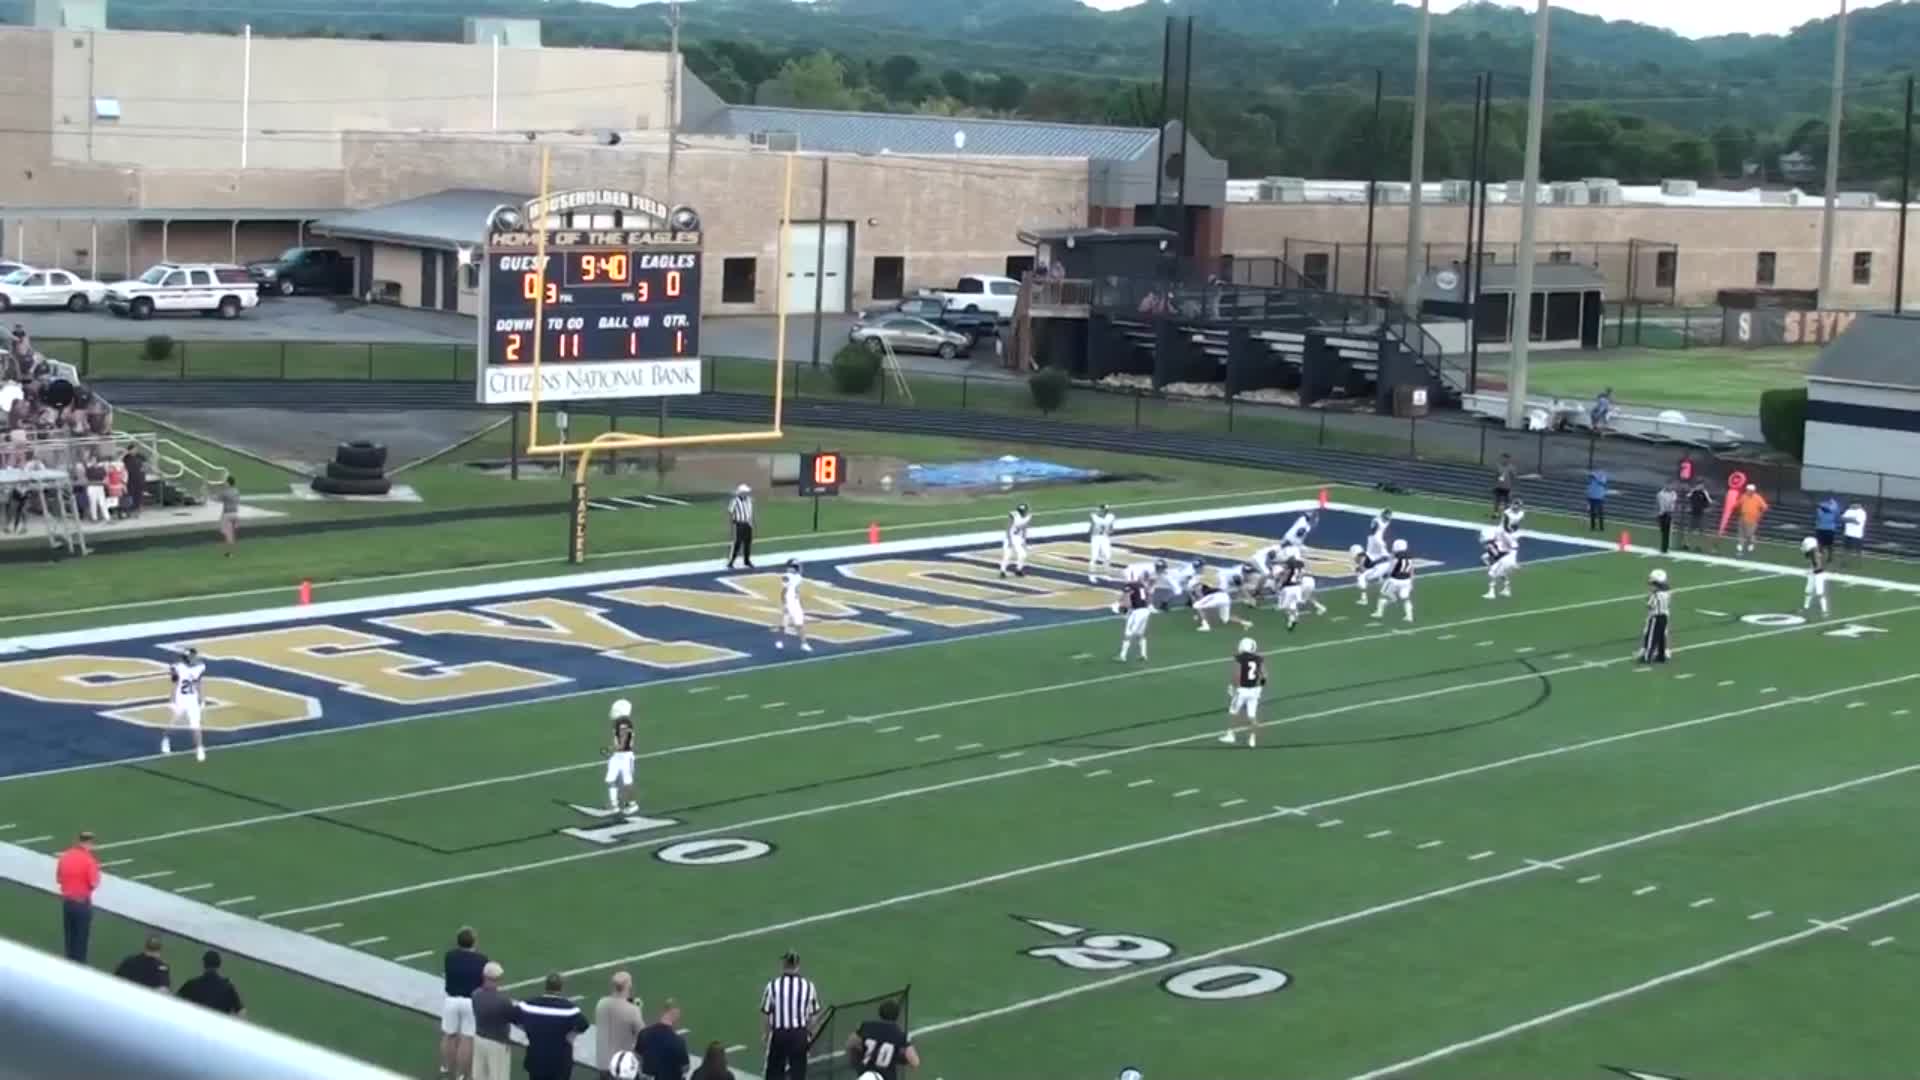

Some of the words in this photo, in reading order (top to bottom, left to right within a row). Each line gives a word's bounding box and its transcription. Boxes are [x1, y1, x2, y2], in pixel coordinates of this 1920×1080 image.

[632, 195, 667, 219] FIELD
[556, 232, 580, 245] OF
[589, 232, 624, 245] THE
[628, 231, 699, 245] EAGLES
[500, 256, 551, 271] GUEST
[582, 255, 627, 280] 9:40
[641, 254, 695, 269] EAGLES
[525, 273, 540, 299] 0
[545, 283, 557, 303] 3
[638, 282, 649, 302] 3
[667, 271, 680, 296] 0
[496, 318, 535, 332] DOWN
[547, 318, 563, 330] TO
[567, 317, 584, 330] GO
[598, 316, 628, 329] BALL
[633, 315, 650, 328] ON
[506, 333, 521, 360] 2
[560, 333, 579, 357] 11
[630, 331, 637, 355] 1
[676, 330, 683, 353] 1
[652, 364, 696, 386] BANK
[815, 455, 836, 483] 18
[1247, 660, 1257, 681] 2
